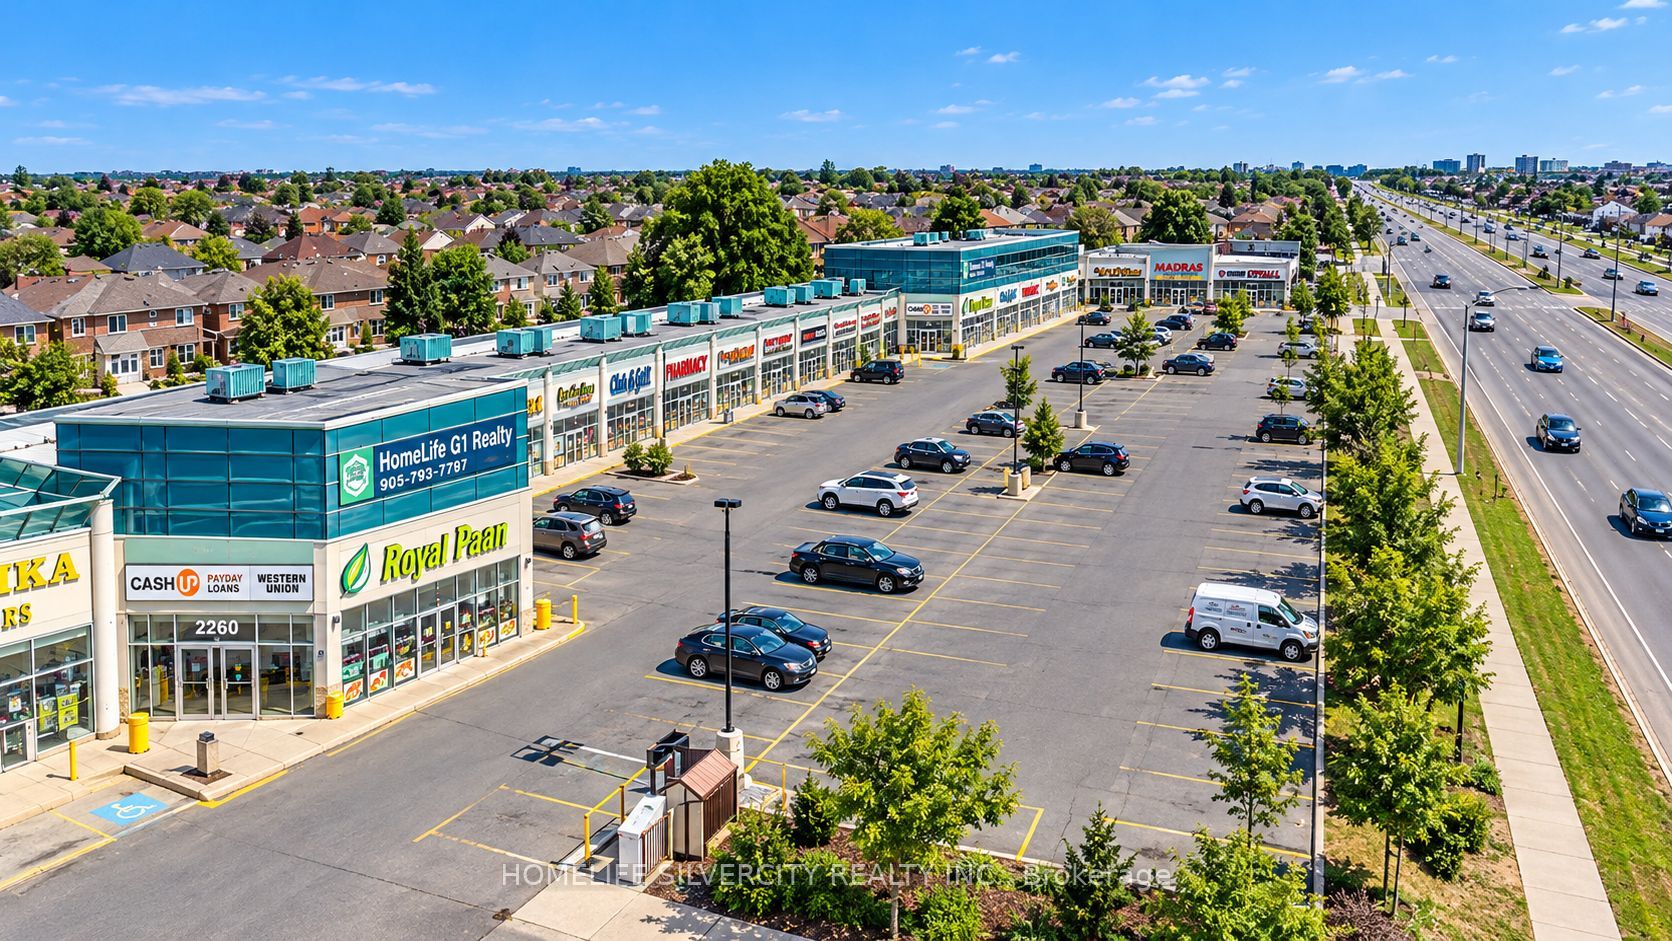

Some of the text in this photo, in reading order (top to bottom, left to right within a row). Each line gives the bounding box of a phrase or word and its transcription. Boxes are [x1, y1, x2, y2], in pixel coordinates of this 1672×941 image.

[1155, 262, 1204, 273] MADRAS
[665, 354, 708, 382] PHARMACY
[379, 425, 514, 473] HomeLife G1 Realty
[382, 521, 509, 582] Royal Paan
[130, 576, 175, 592] CASH
[207, 573, 243, 583] PAYDAY
[257, 573, 306, 583] WESTERN
[207, 583, 240, 593] LOANS
[266, 583, 299, 593] UNION
[195, 619, 239, 636] 2260
